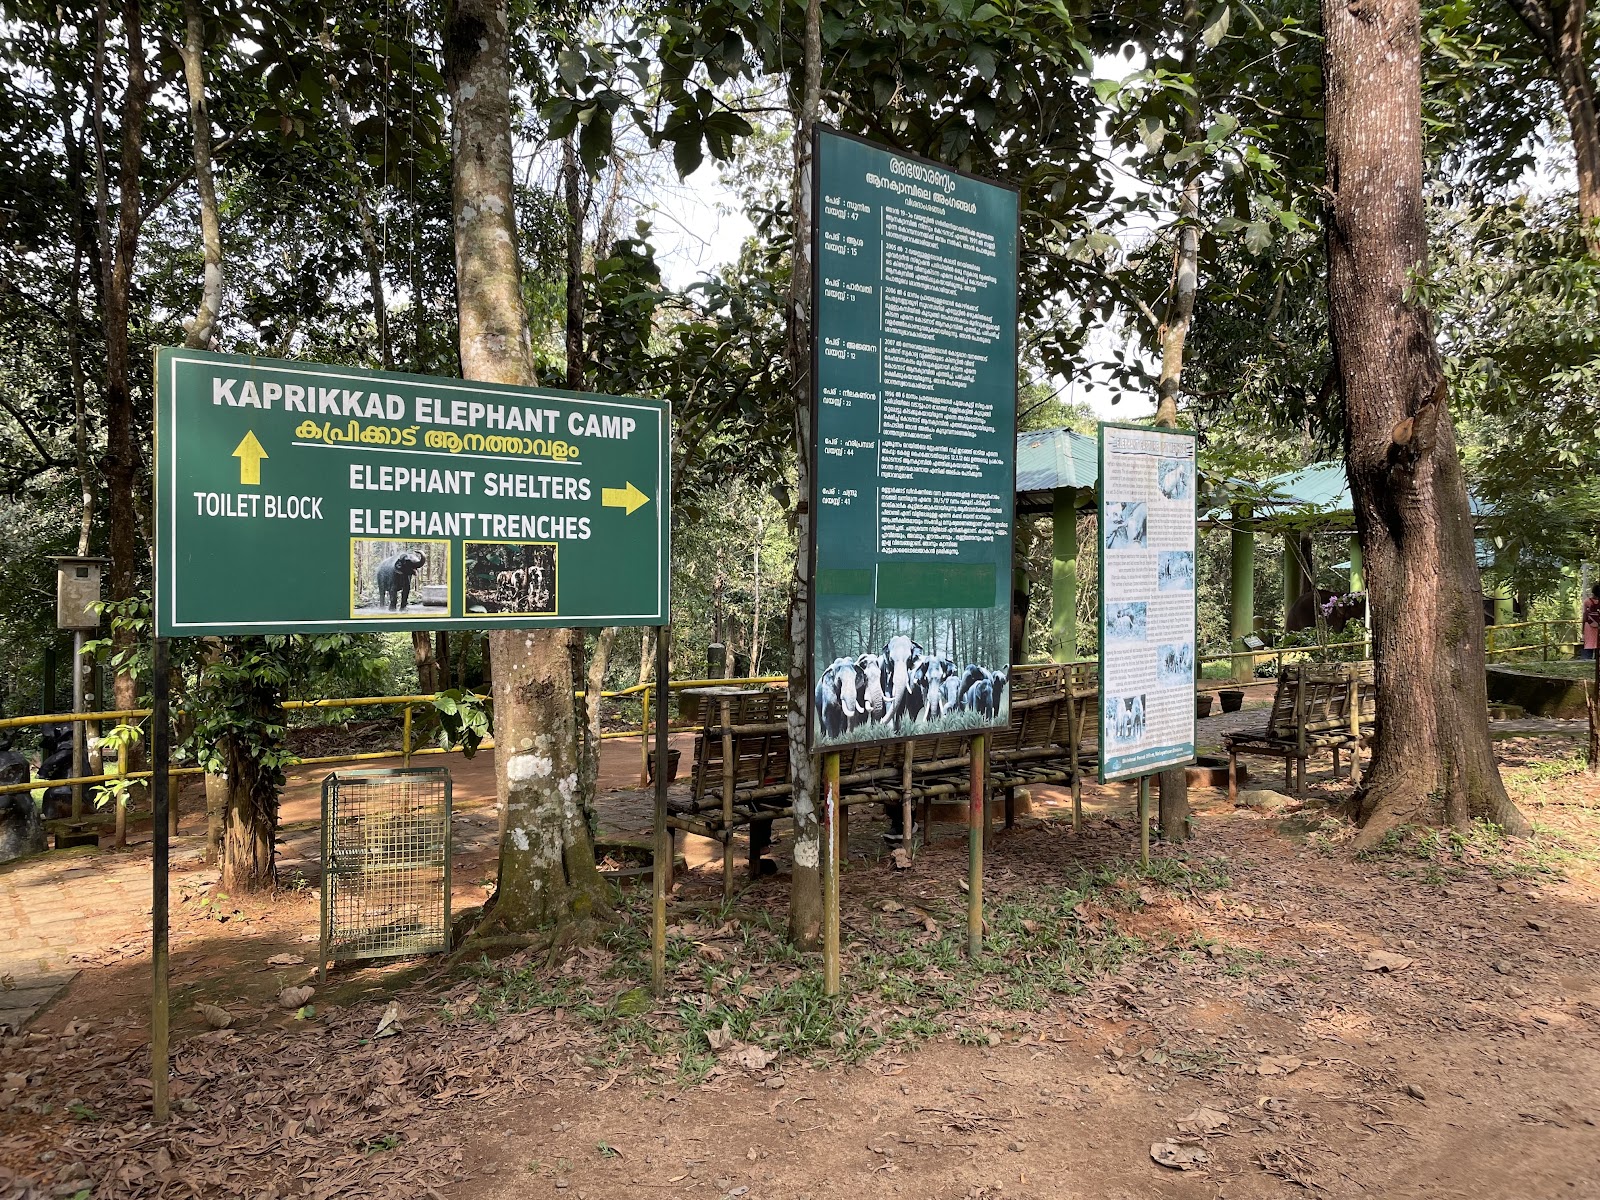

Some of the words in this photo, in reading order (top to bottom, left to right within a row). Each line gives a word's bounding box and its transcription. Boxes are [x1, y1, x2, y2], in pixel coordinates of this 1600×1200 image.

[890, 158, 955, 193] അഭയാരണ്യം
[850, 212, 858, 220] 47
[850, 247, 857, 255] 15
[212, 377, 405, 421] KAPRIKKAD
[415, 397, 561, 434] ELEPHANT
[567, 411, 636, 440] CAMP
[295, 419, 420, 446] കപ്രിക്കാട്
[424, 429, 580, 462] ആനത്താവളം
[349, 463, 476, 496] ELEPHANT
[484, 471, 592, 502] SHELTERS
[194, 491, 263, 518] TOILET
[264, 494, 323, 520] BLOCK
[349, 508, 477, 538] ELEPHANT
[478, 512, 592, 540] TRENCHES
